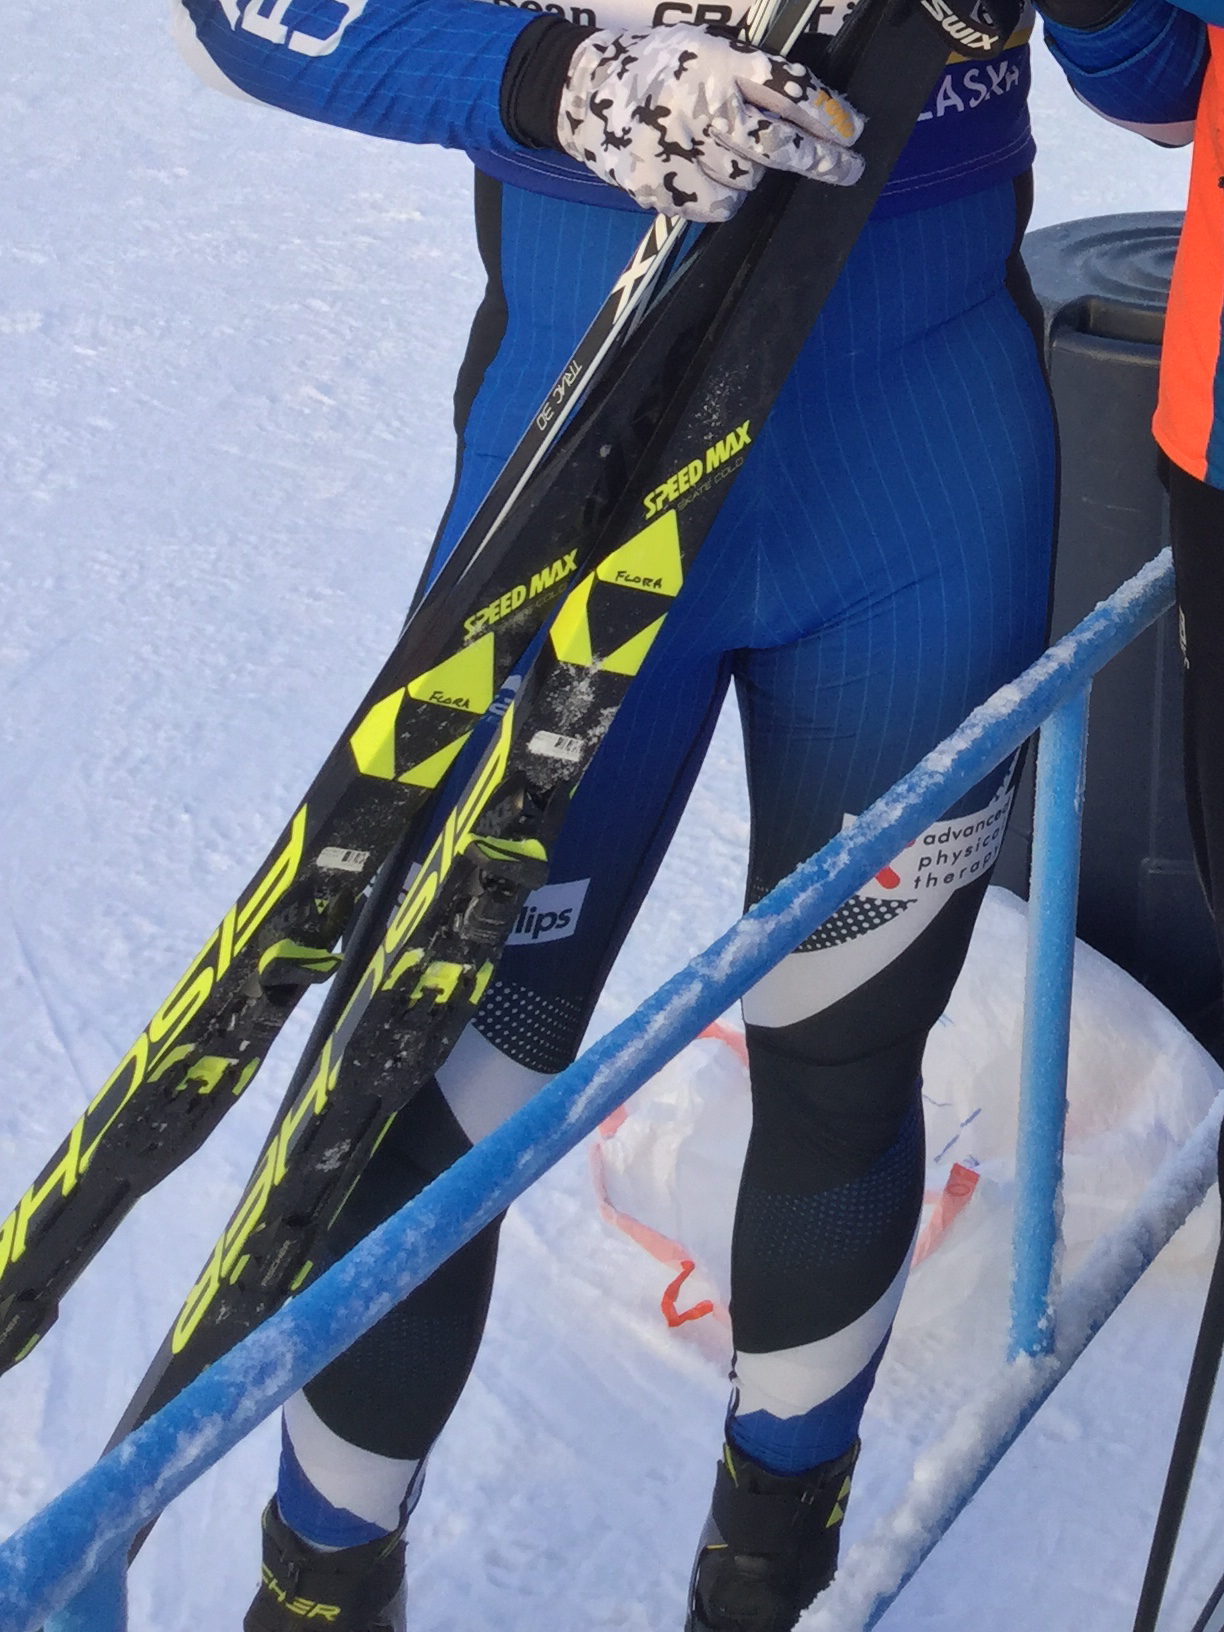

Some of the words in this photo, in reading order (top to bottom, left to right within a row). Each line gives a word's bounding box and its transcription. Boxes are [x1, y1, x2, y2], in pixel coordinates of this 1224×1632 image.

[643, 458, 704, 520] SPEED
[705, 419, 752, 474] MAX
[463, 584, 527, 641] SPEED
[528, 548, 578, 599] MAX
[615, 570, 663, 589] FLORA
[428, 690, 470, 709] FLORA
[922, 795, 1011, 846] advanced
